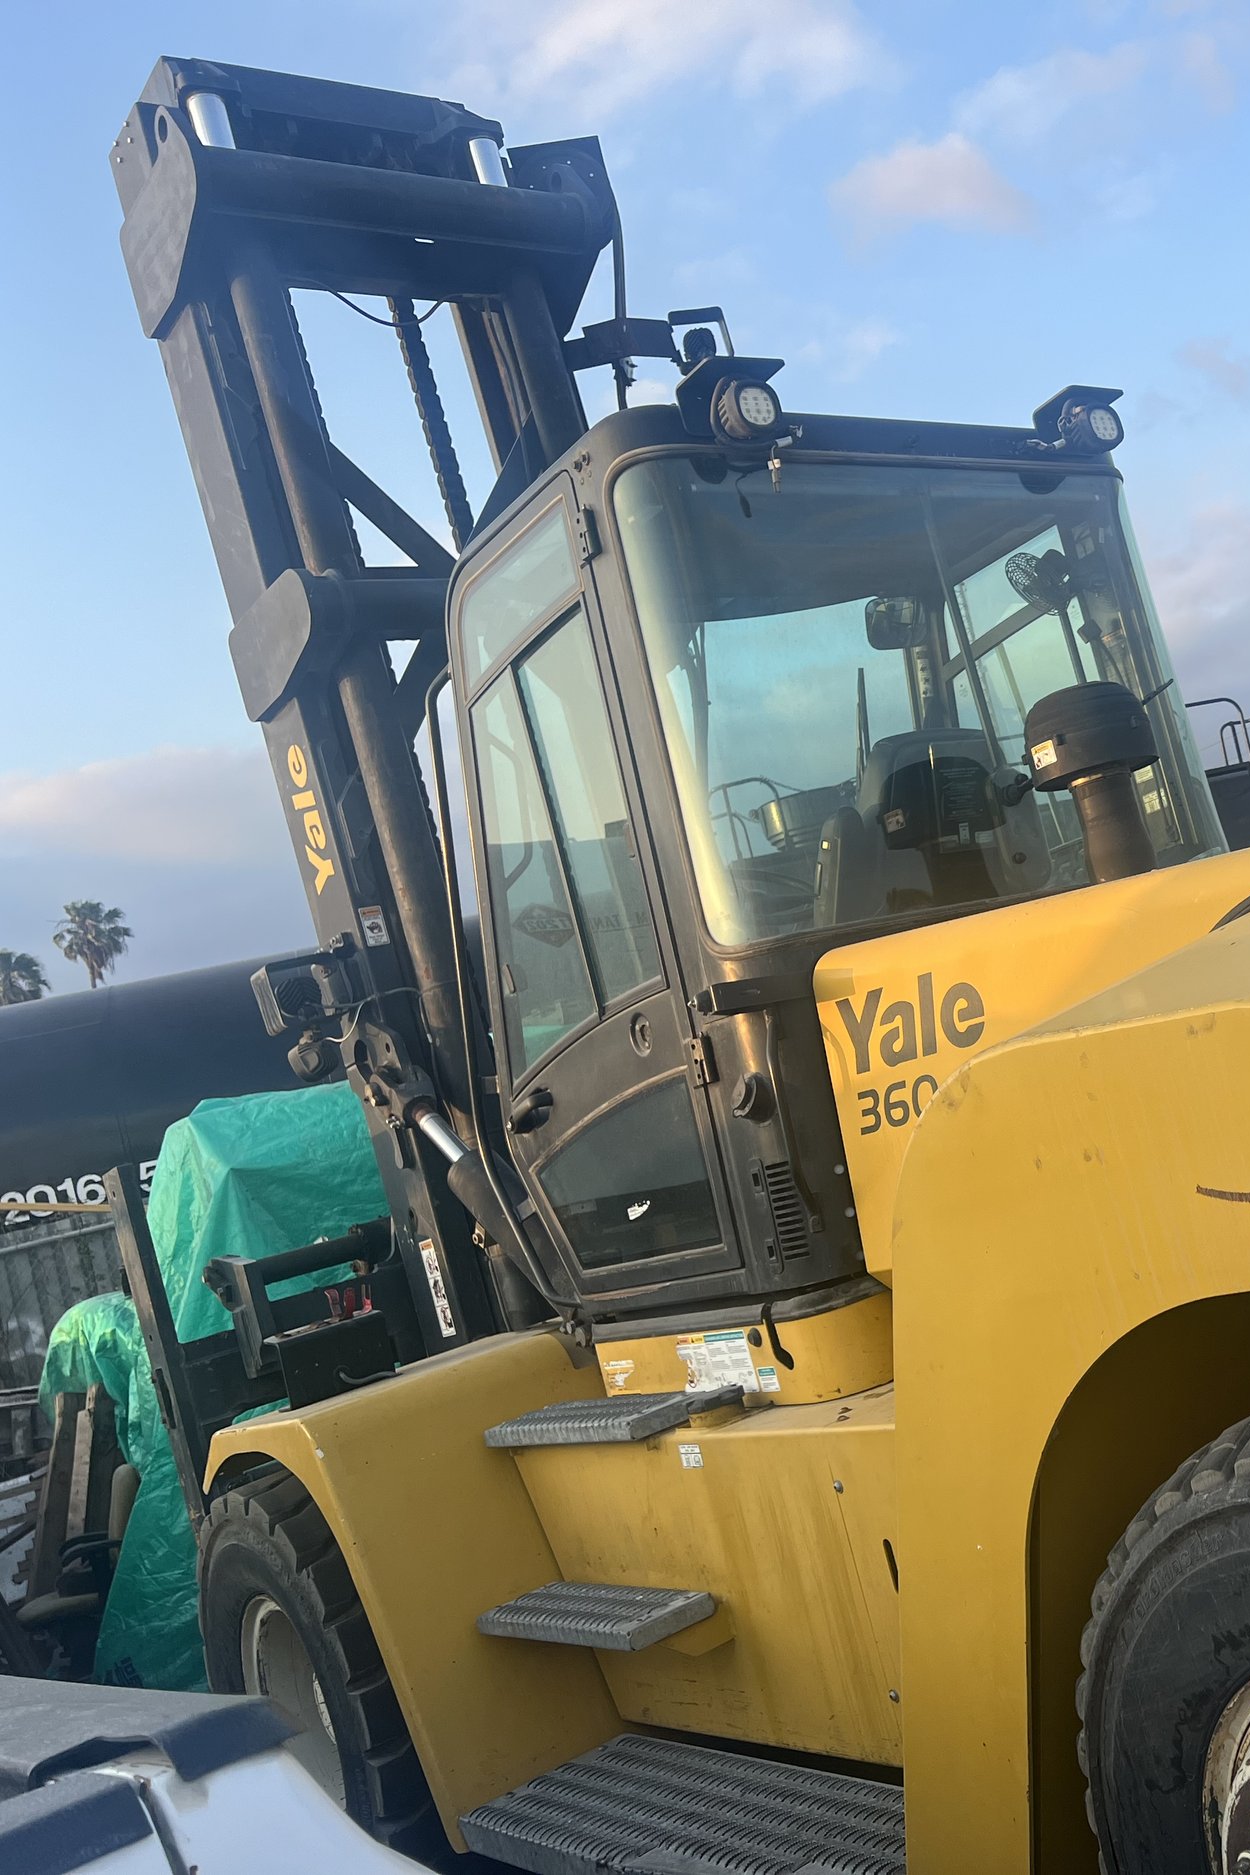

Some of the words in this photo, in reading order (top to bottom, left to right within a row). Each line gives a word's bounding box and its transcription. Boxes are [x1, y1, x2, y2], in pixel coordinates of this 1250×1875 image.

[288, 744, 335, 896] Yale
[835, 971, 985, 1075] Yale
[857, 1074, 939, 1136] 360
